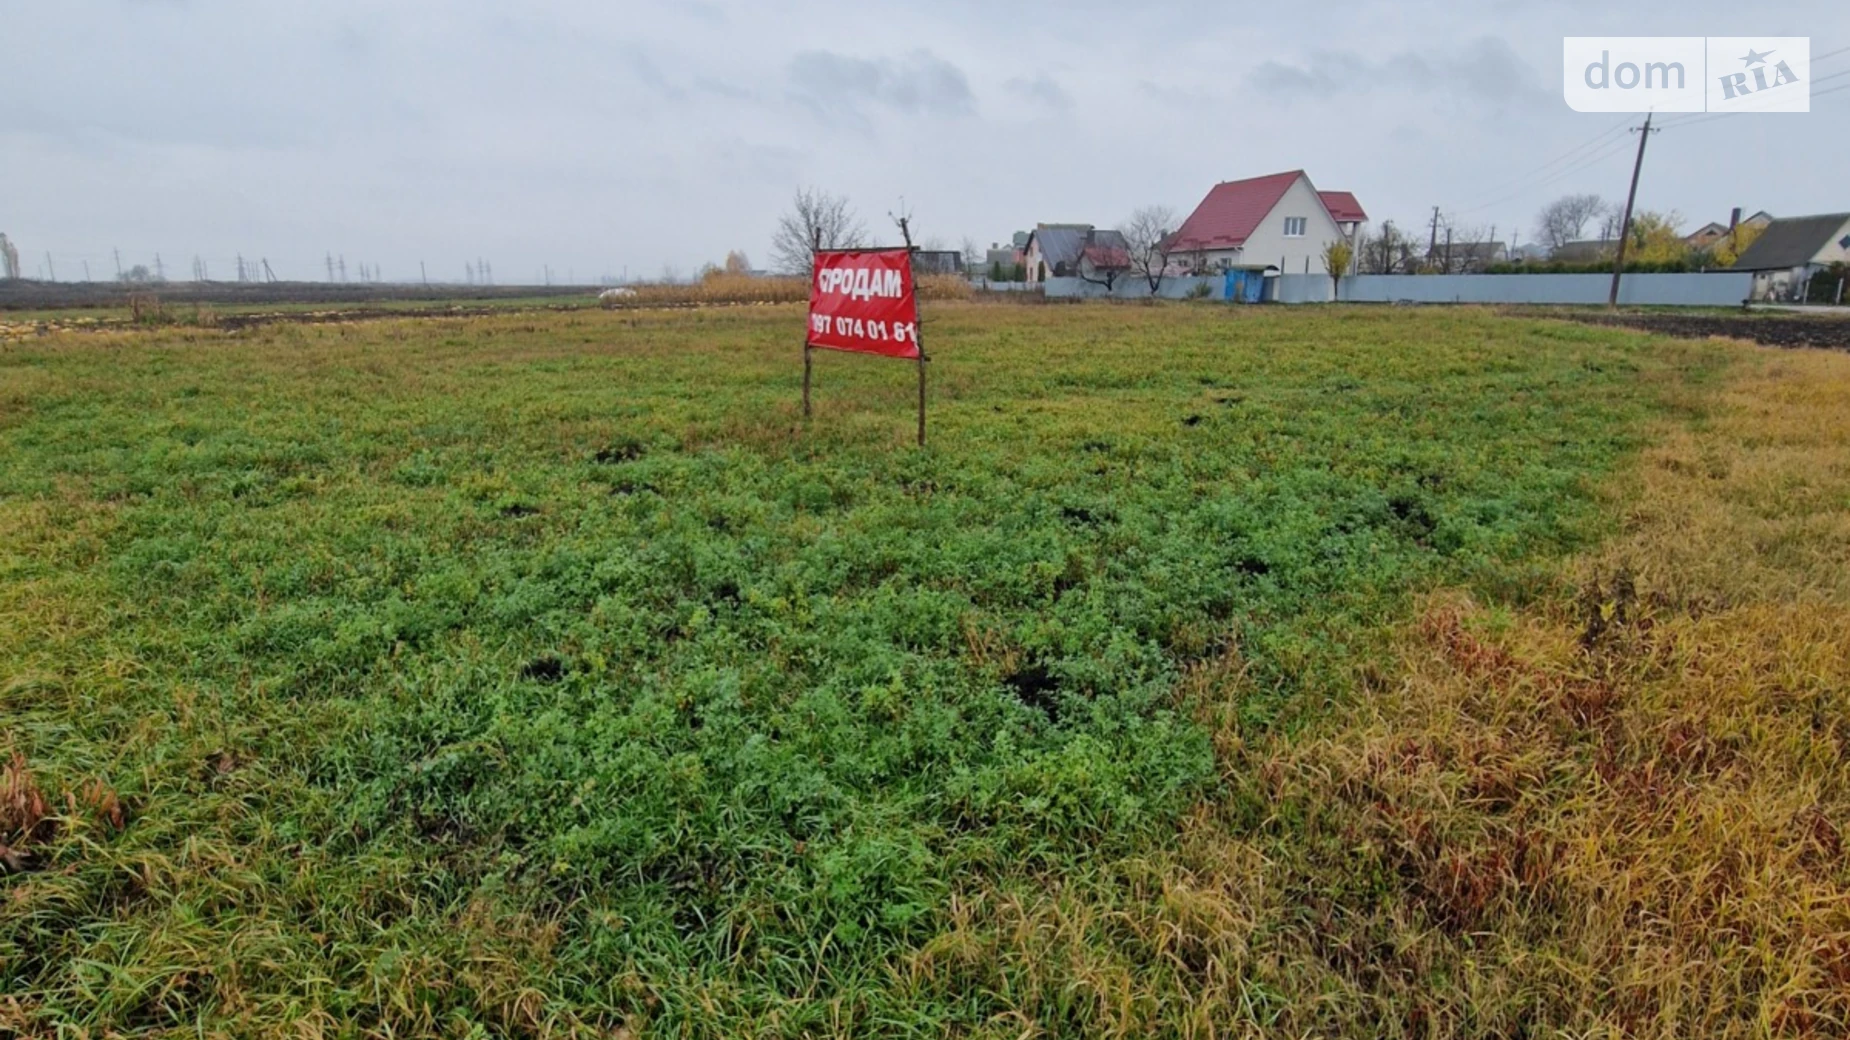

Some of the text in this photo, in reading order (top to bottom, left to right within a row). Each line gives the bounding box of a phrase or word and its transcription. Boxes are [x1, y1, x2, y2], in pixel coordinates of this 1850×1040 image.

[836, 316, 865, 338] 074
[867, 319, 888, 341] 01
[893, 321, 918, 343] 61
